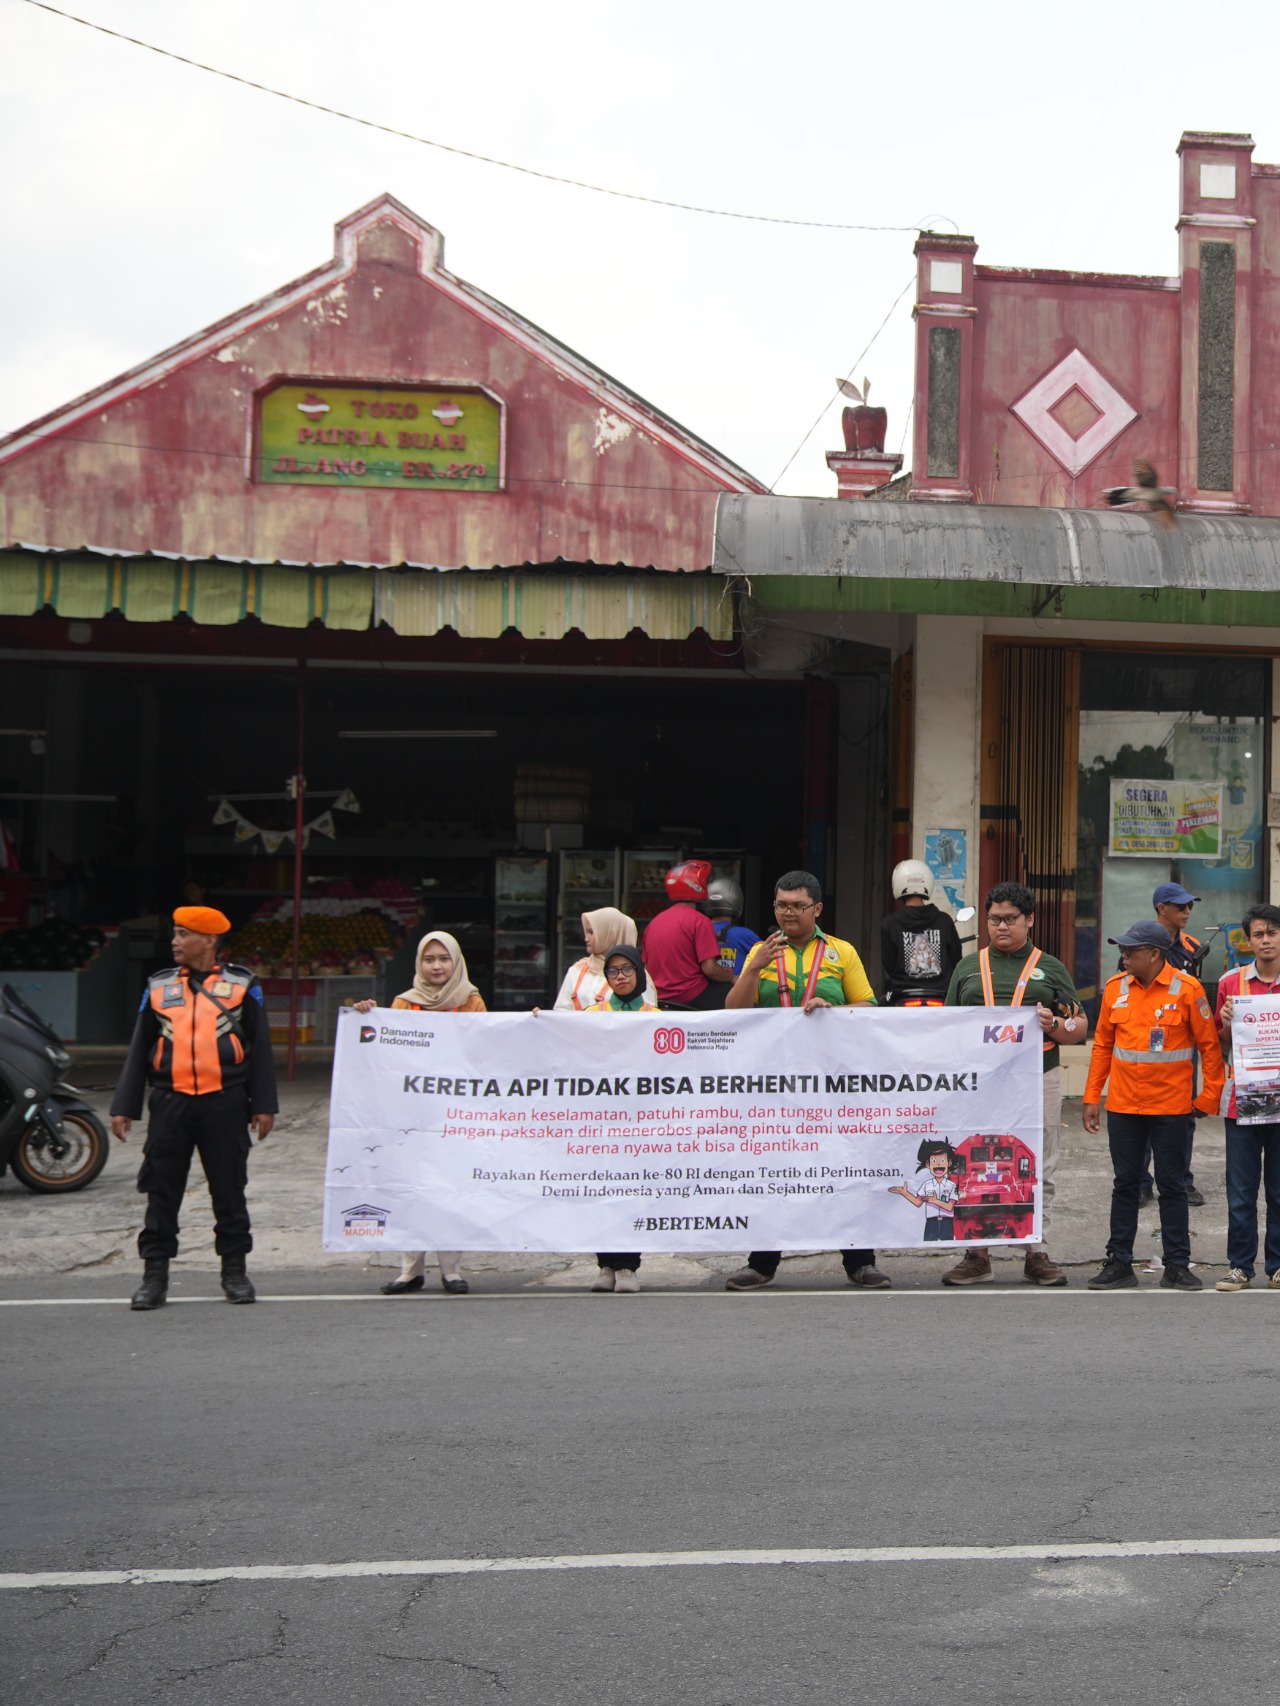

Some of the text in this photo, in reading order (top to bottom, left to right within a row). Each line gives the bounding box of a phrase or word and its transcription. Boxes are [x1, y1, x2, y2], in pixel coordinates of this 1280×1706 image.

[352, 400, 419, 419] TOKO
[298, 427, 465, 450] PATRIA BUAH
[1201, 735, 1241, 744] MENANG
[1126, 788, 1168, 803] SEGERA
[1118, 804, 1175, 818] DIBUTUHKAN
[380, 1026, 434, 1039] Danantara
[654, 1027, 685, 1054] 80
[983, 1025, 1025, 1043] KAI
[379, 1036, 430, 1048] Indonesia
[403, 1072, 978, 1097] KERETA API TIDAK BISA BERHENTI MENDADAK!
[447, 1104, 937, 1123] Utamakan keselamatan, patuhi rambu, dan tunggu dengan sabar
[500, 1124, 573, 1140] paksakan
[578, 1124, 603, 1138] diri
[608, 1123, 692, 1137] menerobos
[697, 1122, 748, 1138] palang
[751, 1122, 791, 1138] pintu
[795, 1120, 833, 1135] demi
[837, 1120, 883, 1134] waktu
[887, 1121, 939, 1135] sesaat,
[567, 1139, 819, 1157] karena nyawa tak bisa digantikan
[473, 1165, 904, 1182] Rayakan Kemerdekaan ke-80 RI dengan Tertib di Perlintasan,
[542, 1182, 834, 1200] Demi Indonesia yang Aman dan Sejahtera
[344, 1228, 384, 1237] MADIUN
[633, 1216, 749, 1232] #BERTEMAN
